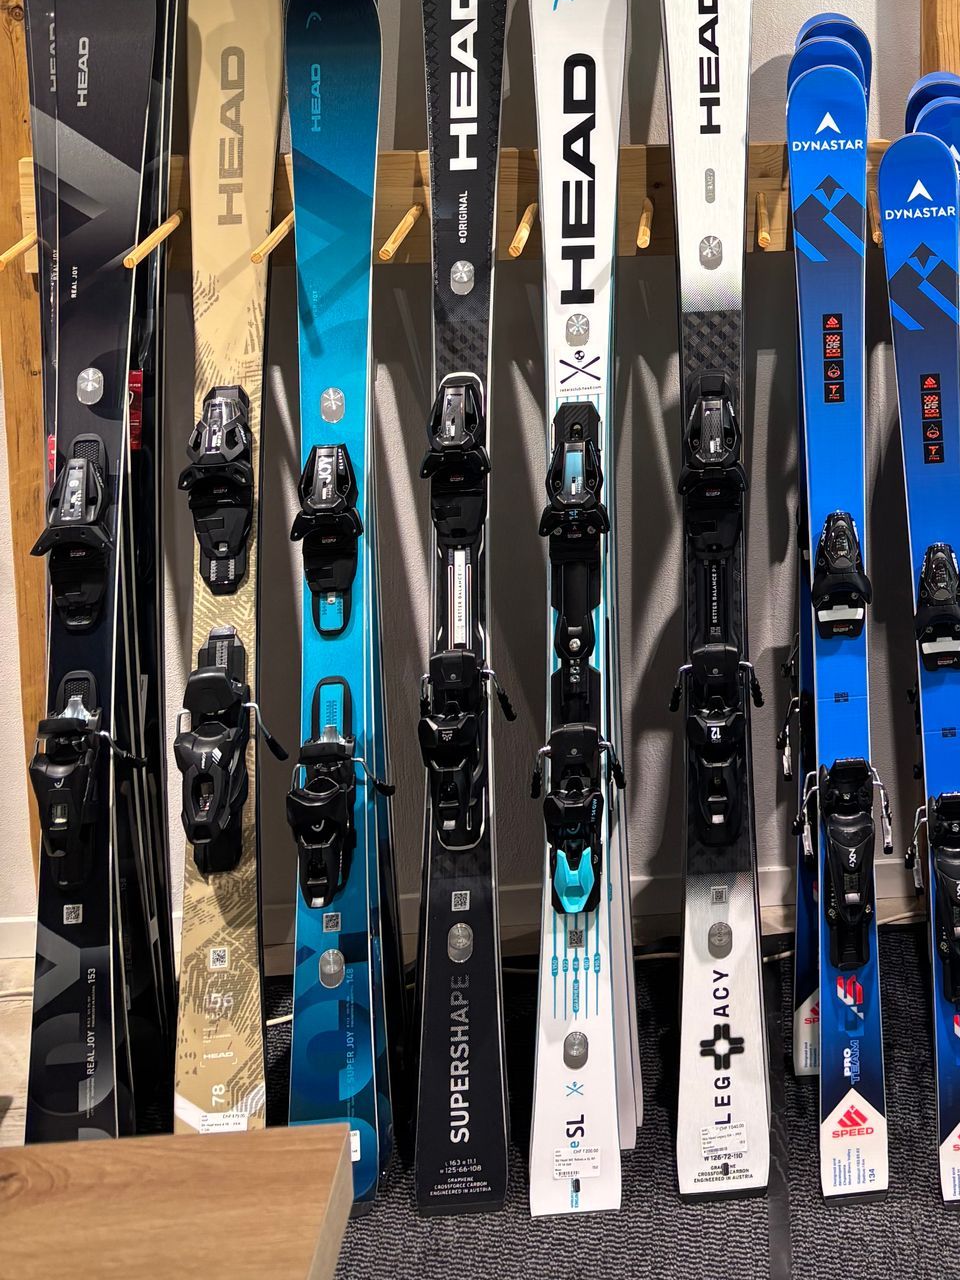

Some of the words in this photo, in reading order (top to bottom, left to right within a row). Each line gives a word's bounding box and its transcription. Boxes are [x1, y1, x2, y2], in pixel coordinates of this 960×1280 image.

[76, 36, 90, 108] HEAD
[310, 63, 322, 133] HEAD
[217, 46, 245, 226] HEAD
[792, 138, 863, 152] DYNASTAR
[560, 53, 597, 304] HEAD
[458, 190, 470, 245] eORIGINAL
[885, 206, 957, 221] DYNASTAR
[711, 727, 721, 739] 12
[87, 967, 96, 984] 153
[346, 967, 354, 984] 148
[86, 1030, 95, 1048] JOY
[345, 1031, 354, 1048] JOY
[86, 1048, 96, 1074] REAL
[203, 1051, 234, 1059] HEAD
[345, 1051, 354, 1083] SUPER
[450, 974, 471, 1143] SUPERSHAPE
[843, 1048, 851, 1076] PRO
[850, 1040, 860, 1084] TEAM
[212, 1083, 226, 1107] 78
[832, 1126, 874, 1139] SPEED
